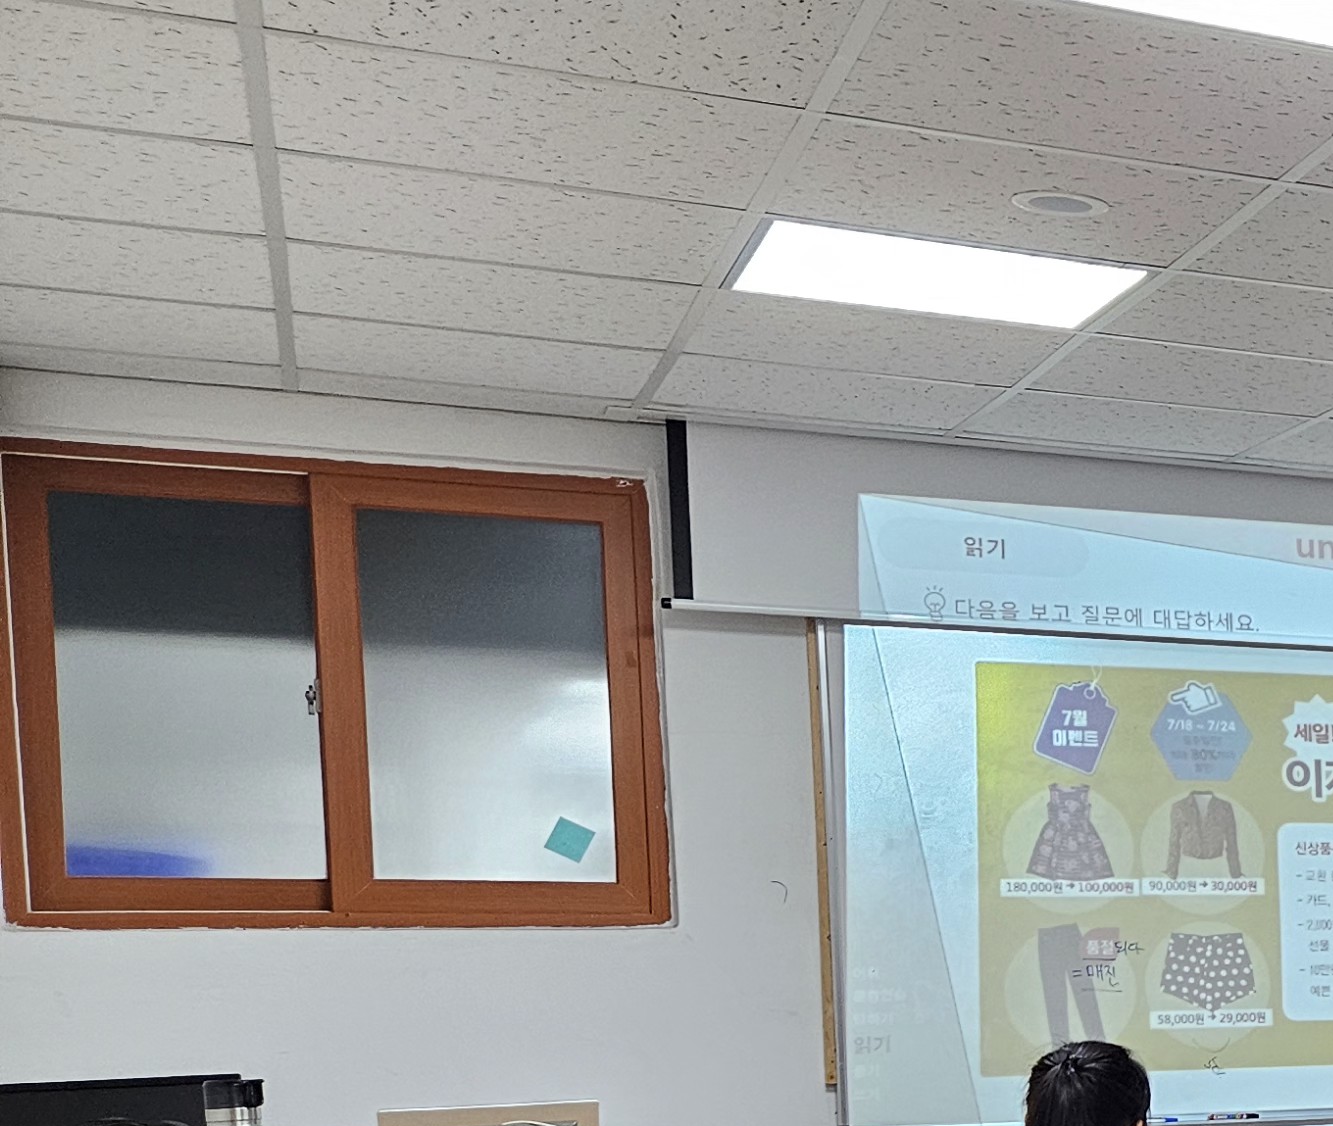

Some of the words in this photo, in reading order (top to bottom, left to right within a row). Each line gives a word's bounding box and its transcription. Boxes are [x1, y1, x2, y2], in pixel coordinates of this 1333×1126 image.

[963, 536, 1006, 560] 읽기
[954, 598, 1020, 622] 다음을
[1031, 603, 1071, 624] 보고
[1081, 604, 1143, 628] 질문에
[1153, 610, 1260, 633] 대답하세요.
[1061, 710, 1088, 727] 7월
[1052, 729, 1099, 747] 이벤트
[1006, 881, 1063, 894] 180,000원
[1078, 881, 1134, 894] 100,000원
[1149, 880, 1197, 892] 90,000원
[1157, 1013, 1204, 1026] 58,000원
[1220, 1012, 1266, 1025] 29,000원
[854, 1035, 891, 1054] 읽기
